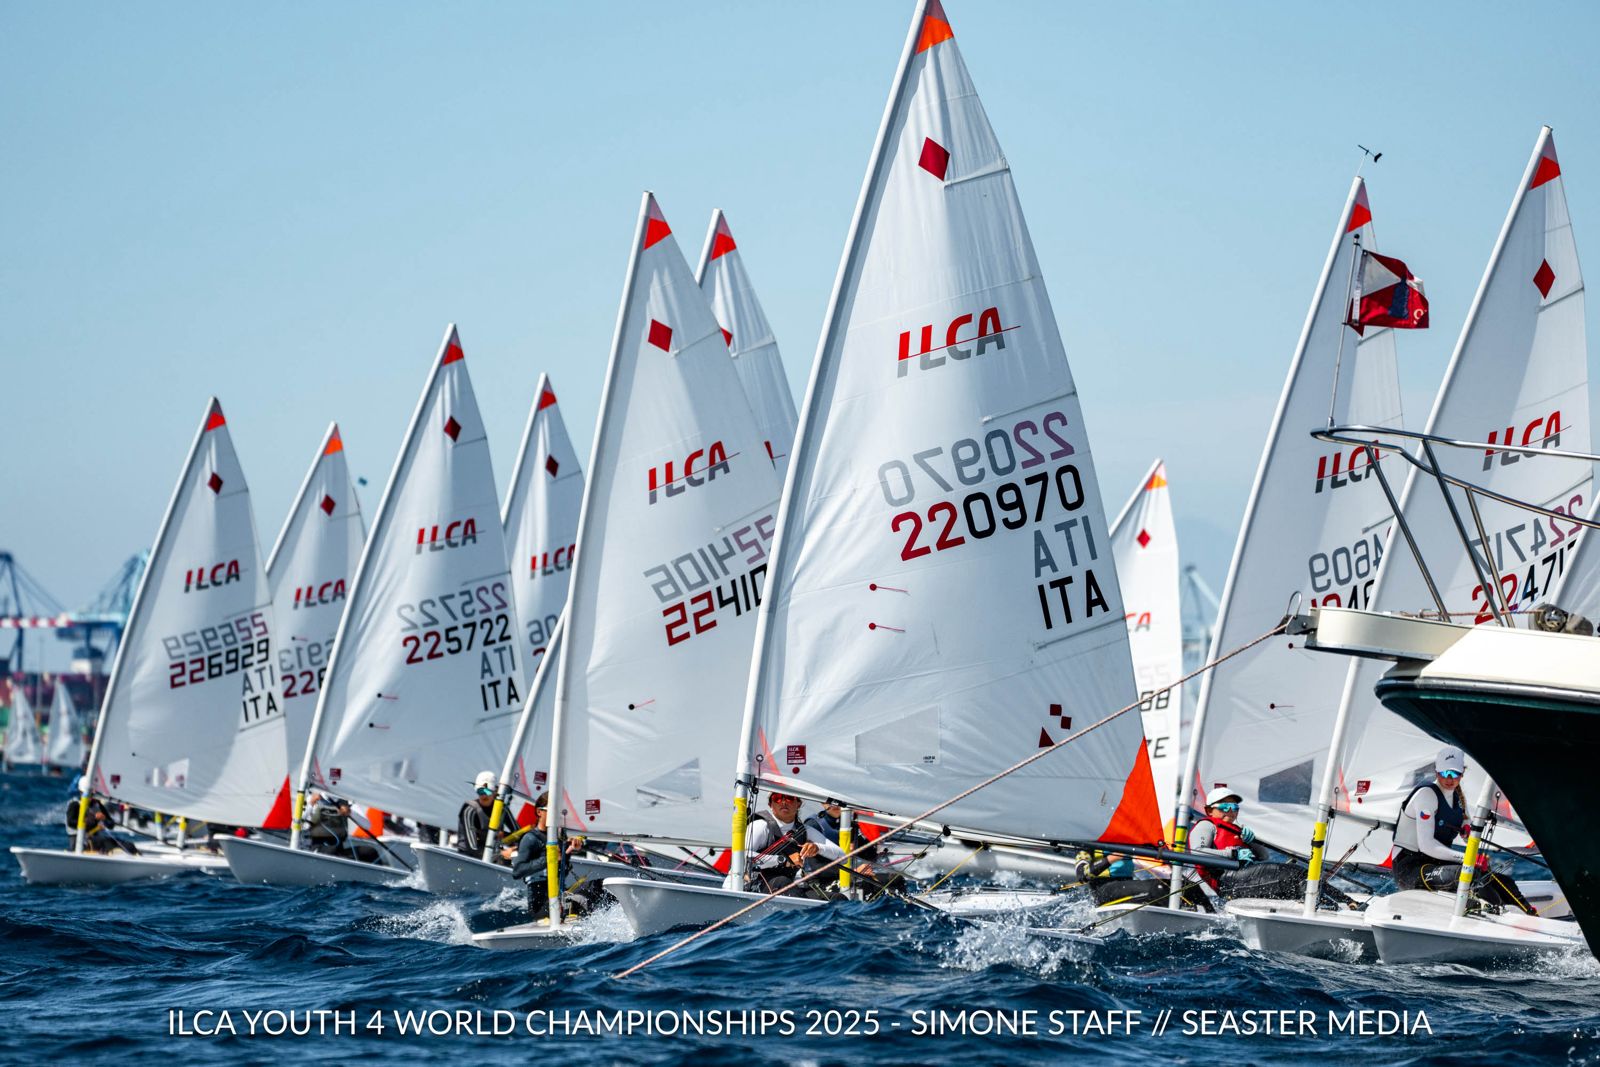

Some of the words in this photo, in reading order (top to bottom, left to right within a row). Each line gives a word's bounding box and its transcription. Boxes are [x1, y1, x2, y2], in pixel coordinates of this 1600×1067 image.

[897, 306, 1006, 378] ILCA
[1482, 410, 1561, 472] ILCA
[648, 440, 731, 505] ILCA
[416, 517, 477, 555] ILCA
[890, 463, 1085, 562] 220970
[184, 559, 240, 593] ILCA
[293, 579, 346, 610] ILCA
[1037, 569, 1110, 630] ITA
[169, 638, 270, 689] 226929
[402, 613, 512, 665] 225722
[242, 692, 278, 723] ITA
[480, 677, 521, 712] ITA
[1146, 736, 1169, 759] E
